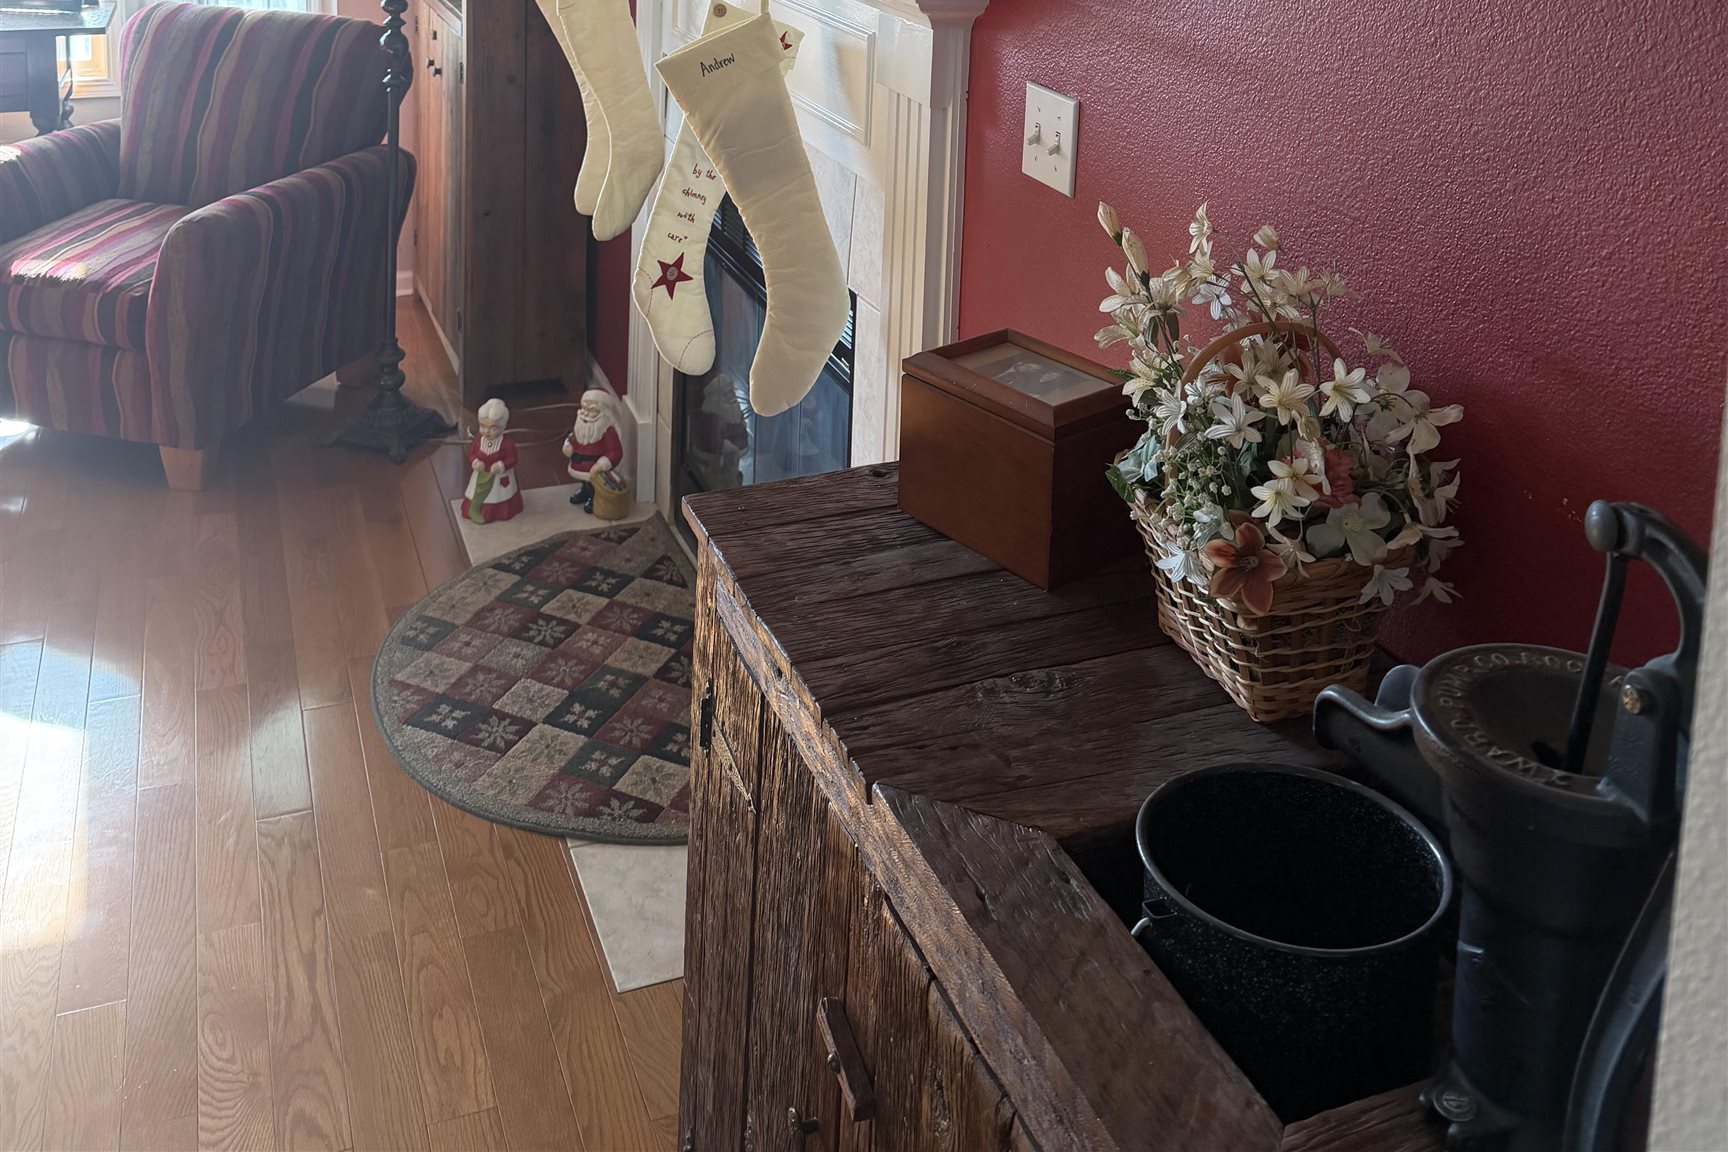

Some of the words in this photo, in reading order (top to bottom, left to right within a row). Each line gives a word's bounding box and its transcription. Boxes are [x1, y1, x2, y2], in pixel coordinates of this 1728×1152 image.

[699, 52, 736, 78] Andrew
[692, 163, 703, 179] by
[705, 168, 717, 181] the
[682, 186, 707, 205] chimney
[677, 211, 696, 224] with
